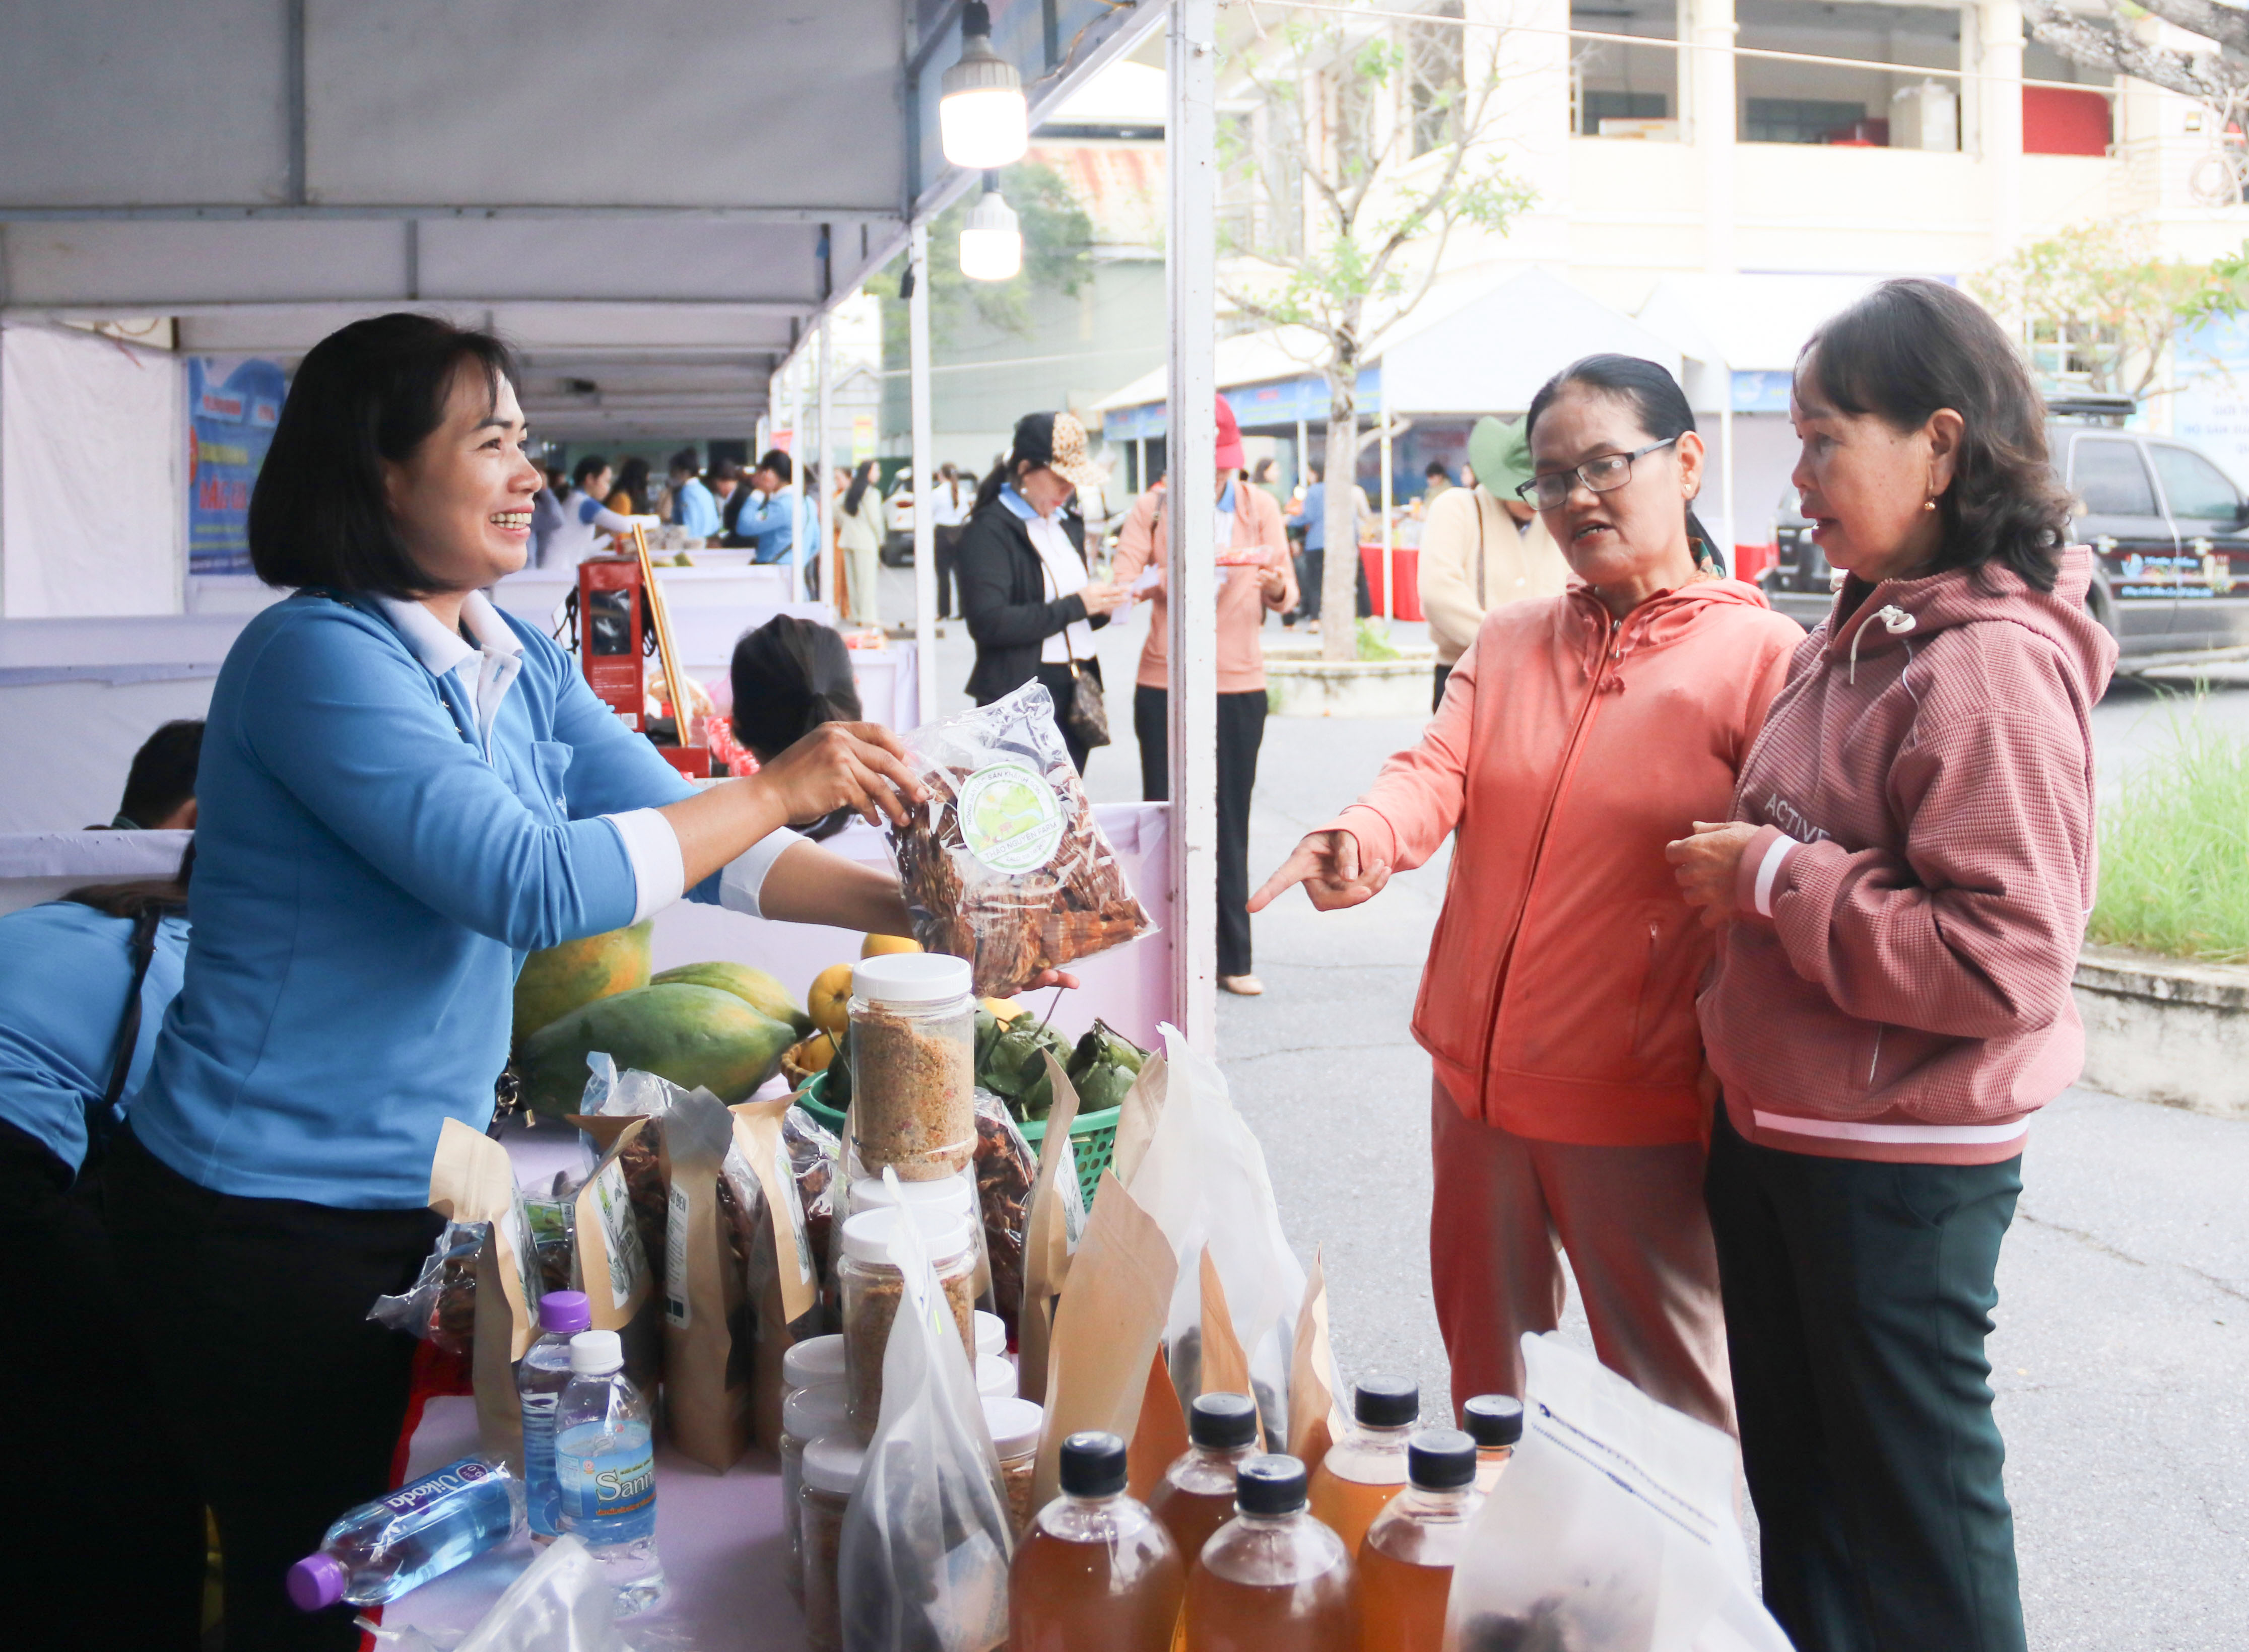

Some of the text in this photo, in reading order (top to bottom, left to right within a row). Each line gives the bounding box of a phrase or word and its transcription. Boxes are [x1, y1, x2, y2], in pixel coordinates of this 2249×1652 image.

[1038, 821, 1057, 836] FARM
[386, 1475, 459, 1507] Vikoda
[596, 1467, 654, 1505] Sann
